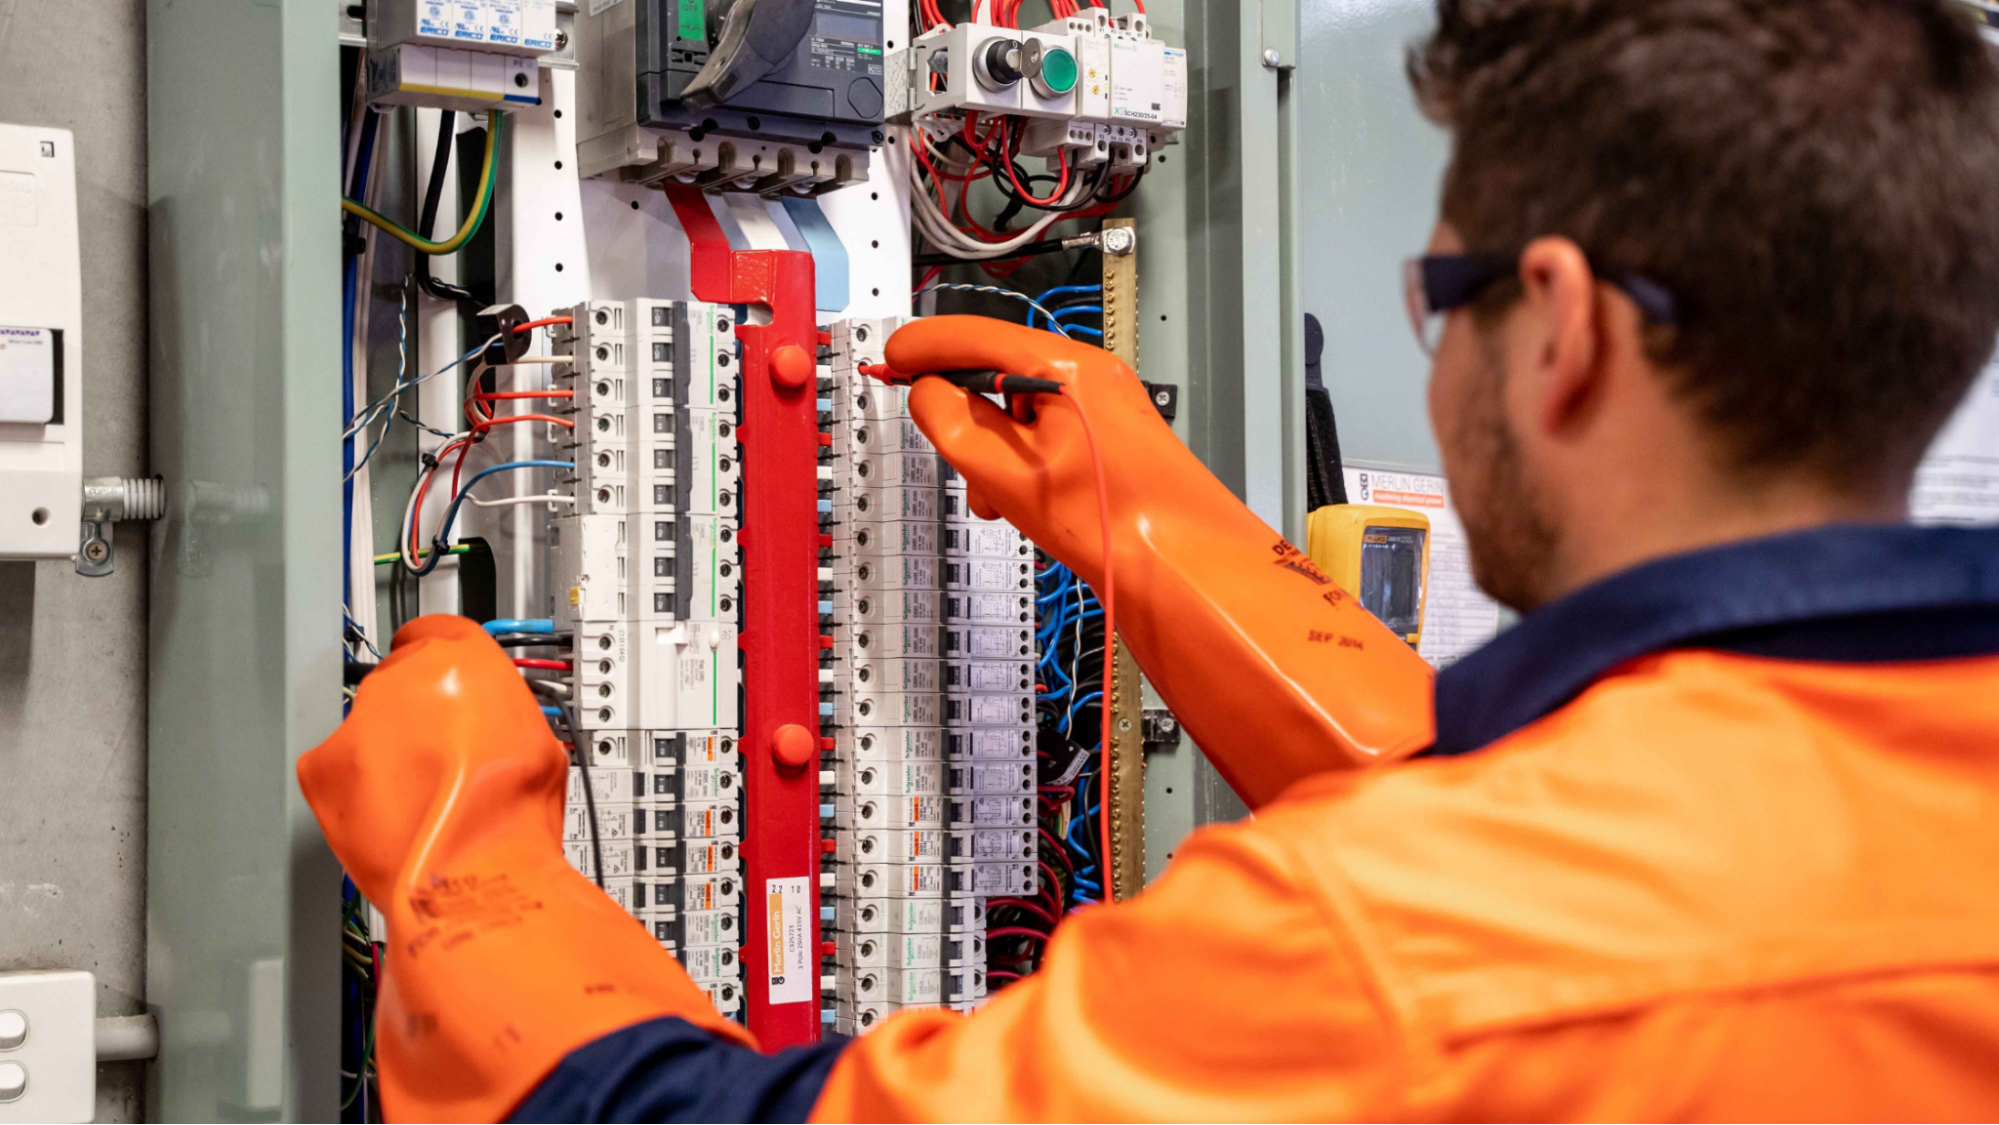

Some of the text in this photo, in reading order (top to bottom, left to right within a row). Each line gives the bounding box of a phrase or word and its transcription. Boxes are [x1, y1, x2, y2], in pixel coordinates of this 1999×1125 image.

[682, 4, 698, 13] OFF
[420, 26, 449, 36] ERICO
[454, 30, 484, 40] ERICO
[490, 34, 518, 44] ERICO
[524, 38, 552, 48] ERICO
[514, 60, 525, 68] PE
[706, 305, 714, 334] Schneider
[900, 387, 908, 416] Schneider
[708, 412, 717, 442] Schneider
[900, 421, 908, 450] Schneider
[901, 456, 910, 484] Schneider
[1371, 474, 1444, 494] MERLIN GERIN
[901, 488, 910, 517] Schneider
[710, 518, 718, 548] Schneider
[902, 523, 910, 552] Schneider
[902, 557, 910, 586] Schneider
[902, 592, 911, 620] Schneider
[902, 626, 911, 654] Schneider
[1308, 630, 1364, 652] SEP 2014
[902, 661, 910, 690] Schneider
[902, 695, 911, 724] Schneider
[904, 730, 913, 759] Schneider
[710, 768, 720, 797] Schneider
[905, 764, 914, 794] Schneider
[796, 906, 802, 915] AC
[908, 902, 916, 931] Schneider
[710, 913, 719, 942] Schneider
[772, 911, 782, 973] Merlin Gerin
[712, 947, 720, 978] Schneider
[906, 937, 915, 966] Schneider
[908, 972, 917, 1001] Schneider
